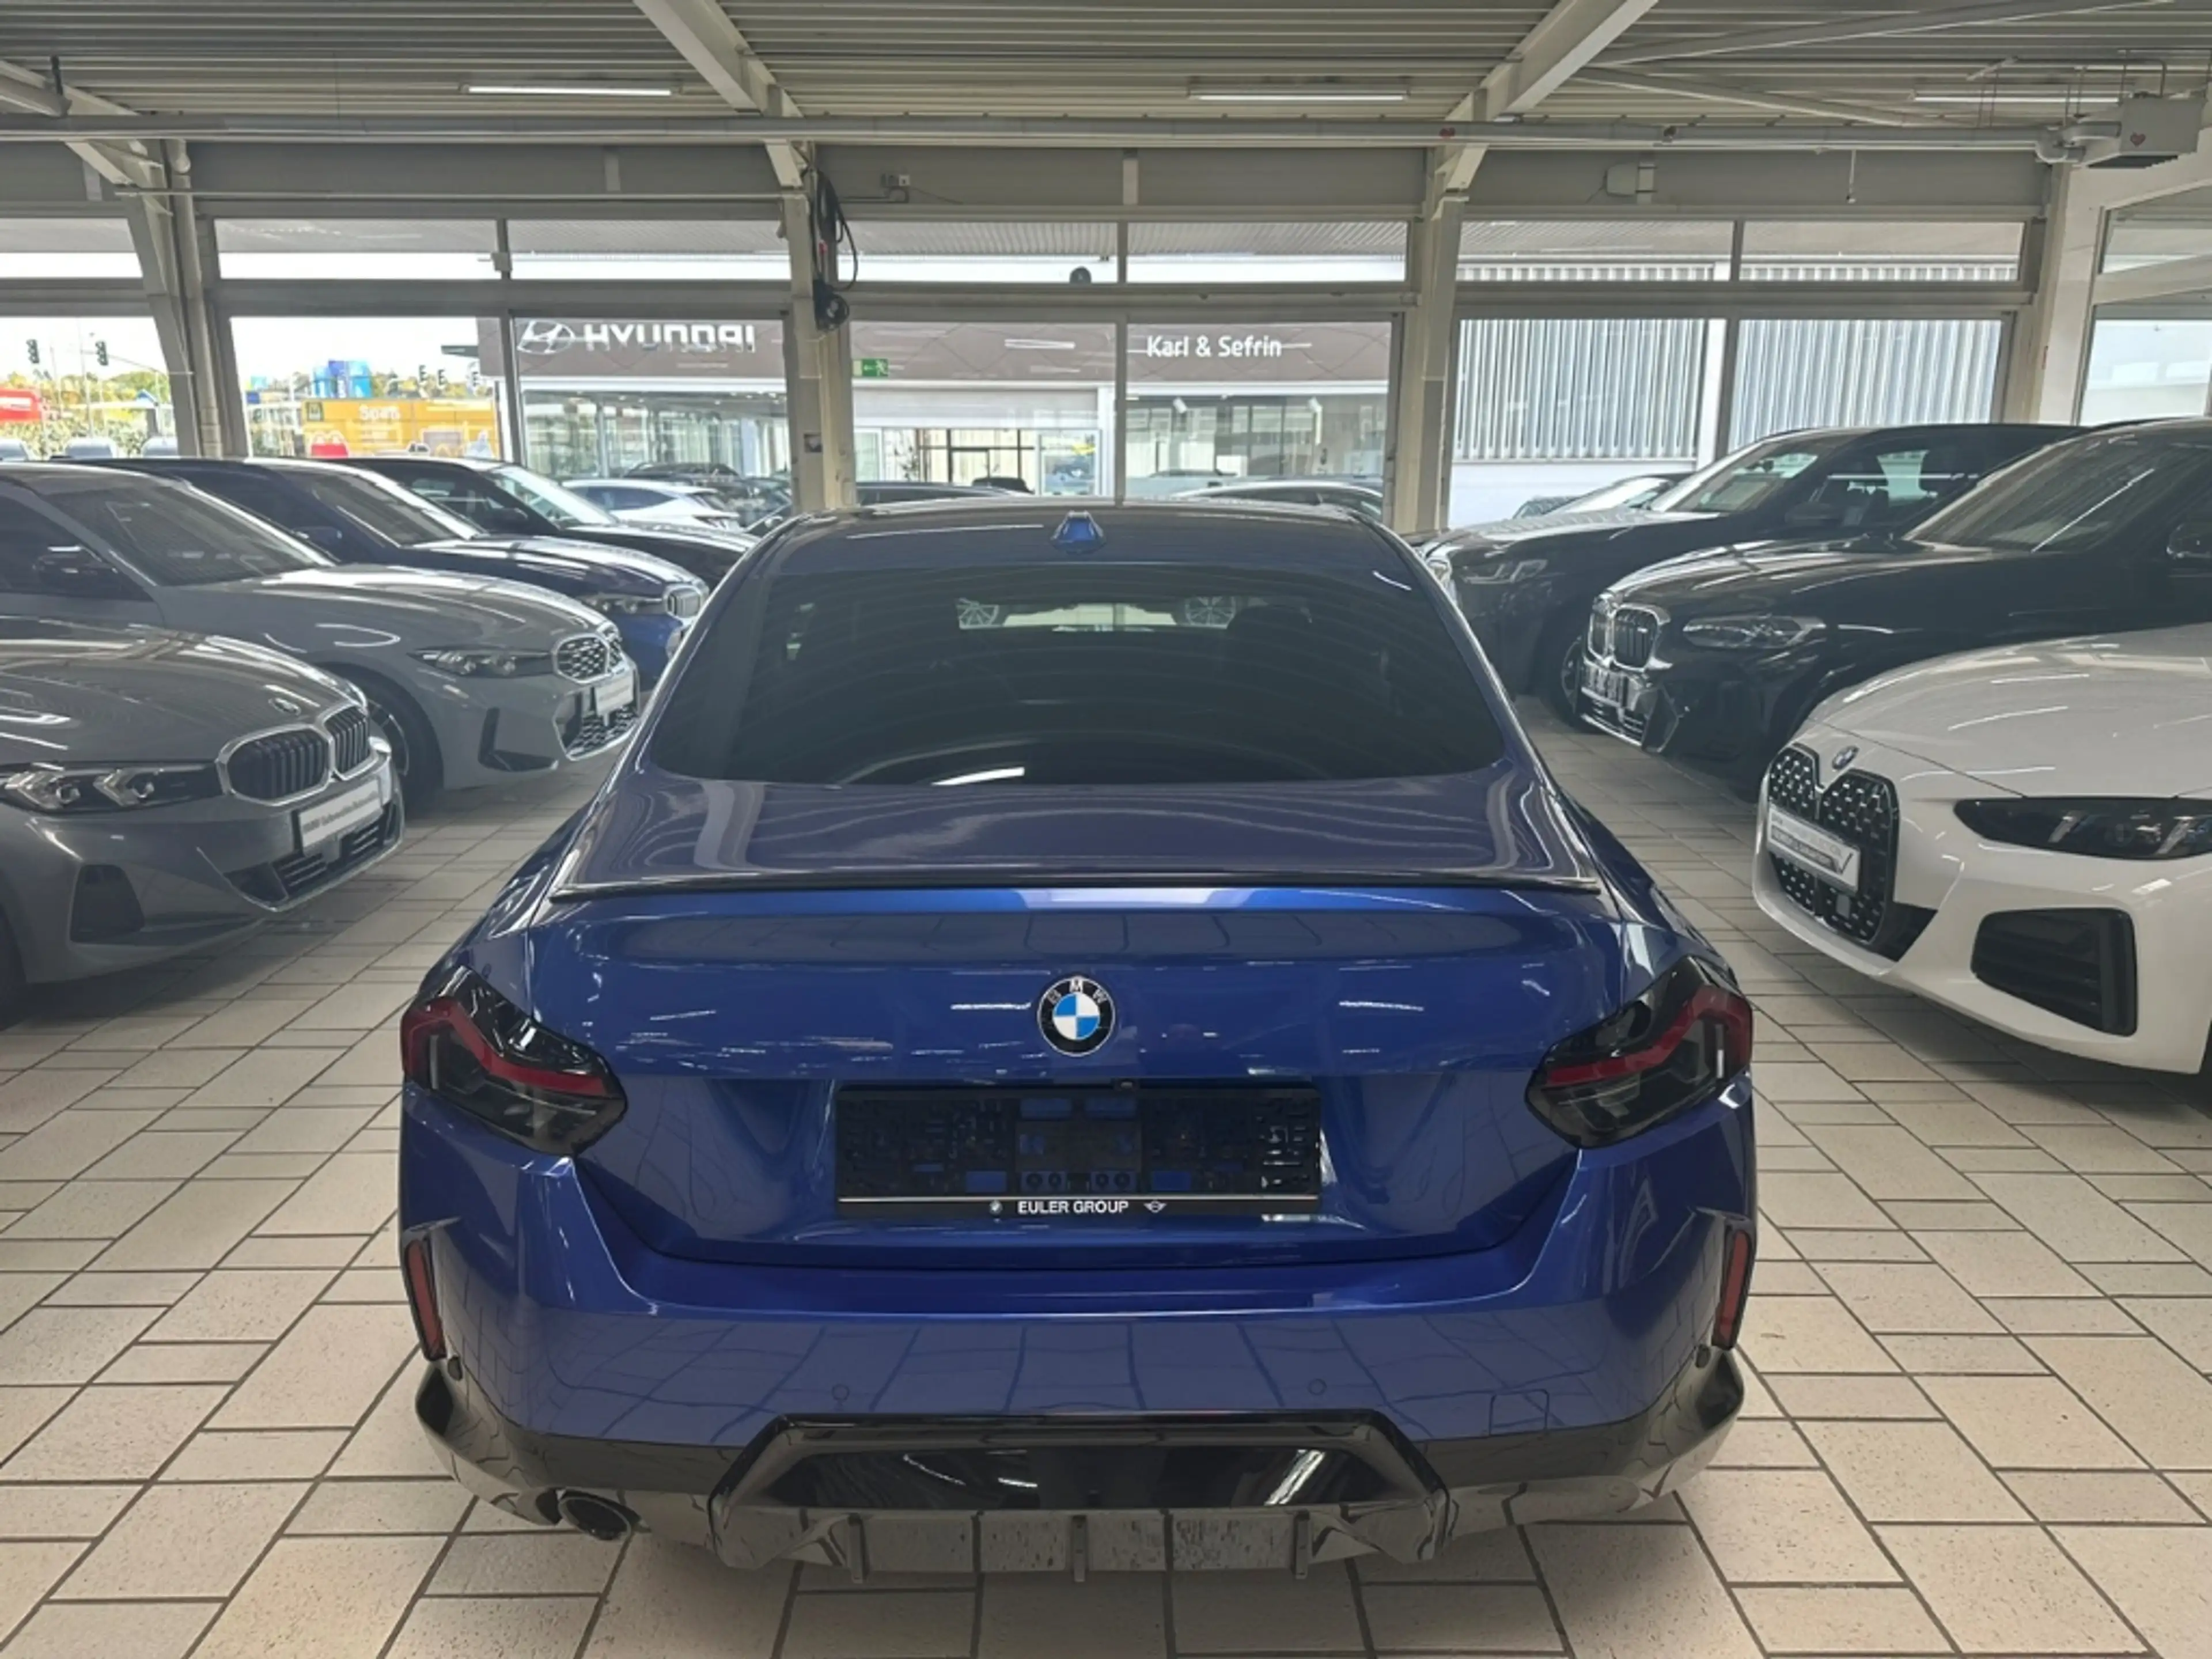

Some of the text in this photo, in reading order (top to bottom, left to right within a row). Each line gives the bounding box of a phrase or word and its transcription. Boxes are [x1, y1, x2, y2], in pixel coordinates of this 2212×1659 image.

[584, 324, 756, 353] HYUNDAI
[1146, 334, 1282, 357] Karl & Sefrin
[1047, 979, 1107, 1004] BMW
[1018, 1200, 1128, 1214] EULER GROUP
